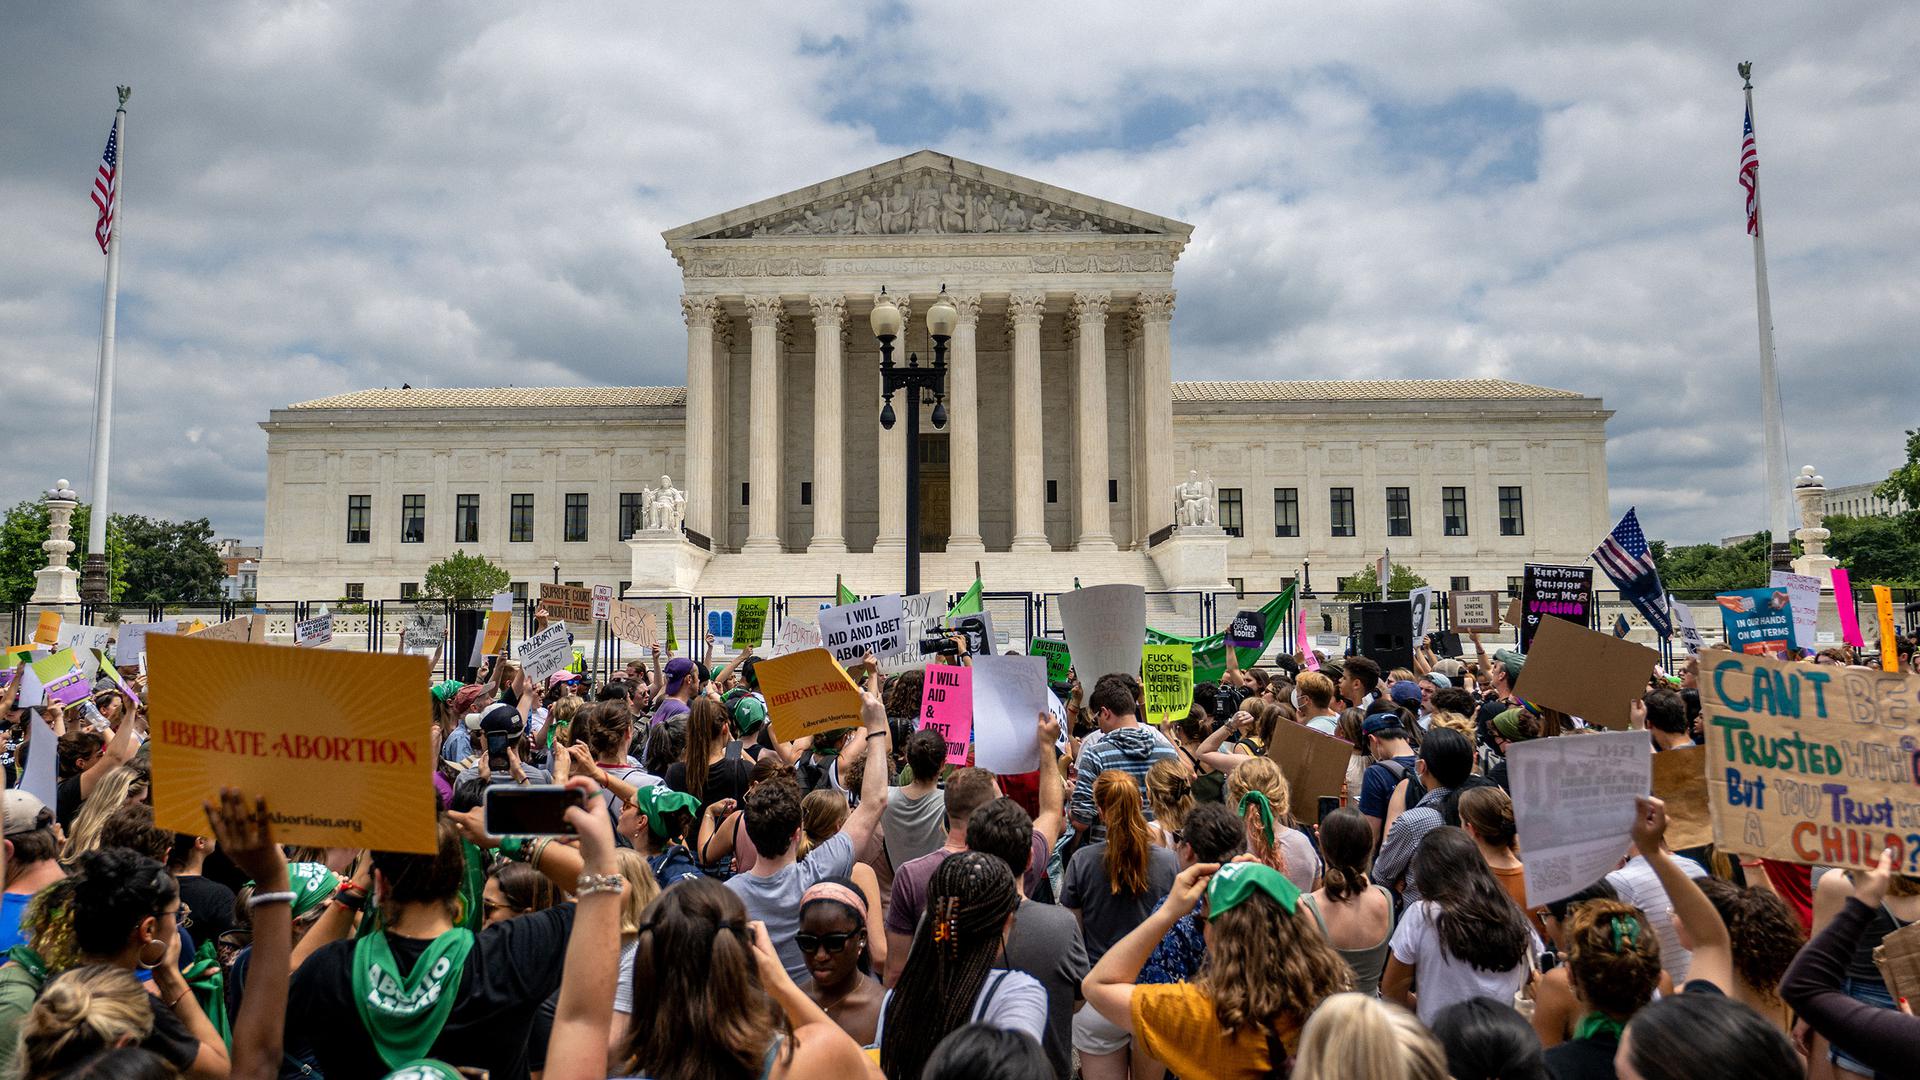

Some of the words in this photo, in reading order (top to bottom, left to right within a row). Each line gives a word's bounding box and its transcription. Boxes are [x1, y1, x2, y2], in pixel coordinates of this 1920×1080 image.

[835, 261, 882, 273] EQUAL
[884, 261, 937, 272] JUSTICE
[943, 260, 988, 272] UNDER
[992, 260, 1019, 272] LAW
[542, 586, 570, 600] SUPREME
[573, 589, 591, 602] COURT
[573, 607, 589, 621] RULE
[620, 603, 646, 624] HEX
[1529, 600, 1583, 615] VAGINA
[845, 612, 851, 625] I
[853, 606, 880, 623] WILL
[1736, 619, 1746, 628] IN
[1746, 618, 1760, 627] OUR
[1760, 615, 1786, 625] HANDS
[828, 632, 848, 647] AID
[850, 625, 873, 642] AND
[875, 618, 901, 637] ABET
[1234, 629, 1256, 639] BODIES
[1244, 625, 1257, 633] OUR
[1737, 631, 1750, 640] ON
[1750, 629, 1762, 639] OUR
[1763, 627, 1790, 637] TERMS
[518, 623, 564, 656] PRO-ABORTION
[1147, 654, 1174, 663] FUCK
[1147, 663, 1188, 673] SCOTUS
[929, 671, 934, 684] I
[936, 672, 960, 687] WILL
[1148, 674, 1179, 683] WE'RE
[770, 683, 822, 707] LIBERATE
[927, 688, 946, 703] AID
[1149, 684, 1180, 693] DOING
[1713, 659, 1831, 719] CAN'T
[1844, 673, 1909, 730] BE
[1150, 694, 1158, 703] IT
[925, 704, 935, 719] &
[1150, 703, 1188, 713] ANYWAY
[161, 719, 268, 758] LIBERATE
[271, 732, 418, 765] ABORTION
[944, 741, 965, 757] RTION
[1774, 778, 1822, 818] YOU
[1743, 812, 1765, 848] A
